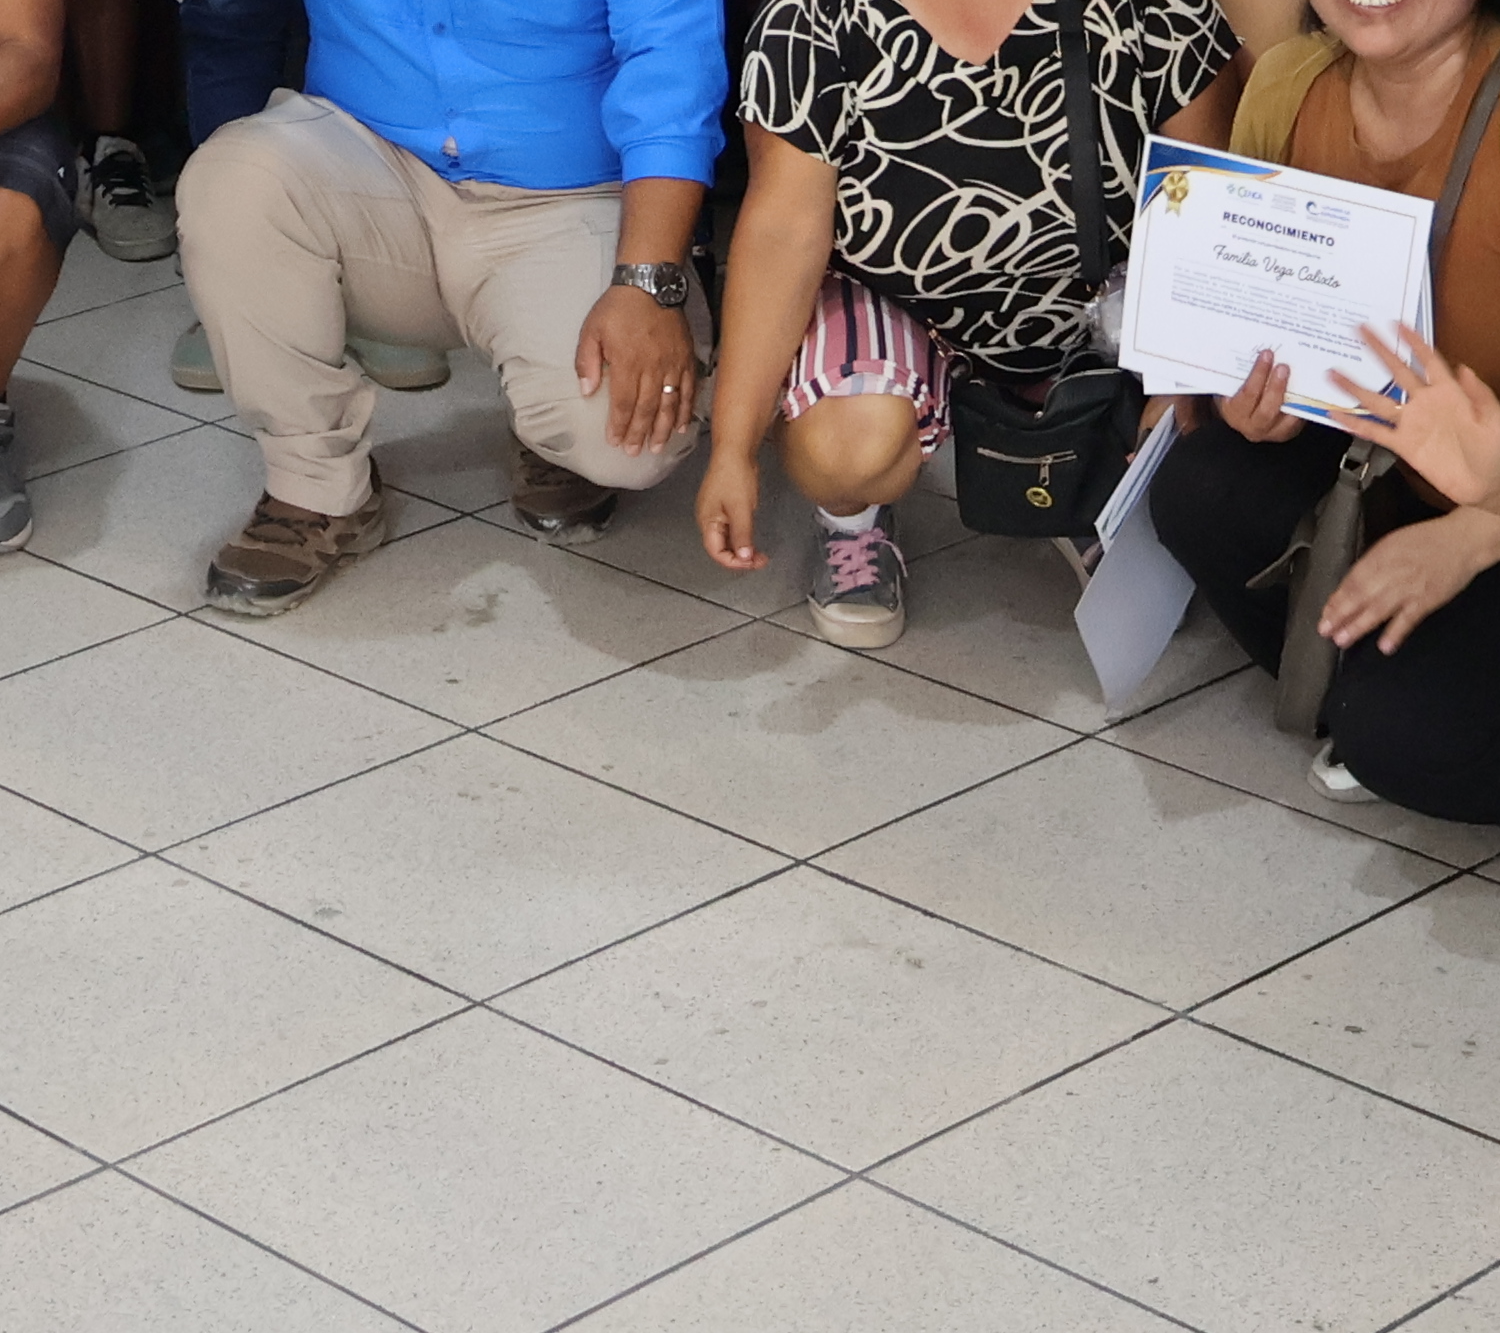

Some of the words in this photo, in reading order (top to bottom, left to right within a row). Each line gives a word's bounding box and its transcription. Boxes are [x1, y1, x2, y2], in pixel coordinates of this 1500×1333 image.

[1223, 211, 1335, 247] RECONOCIMIENTO
[1213, 244, 1258, 268] Familia
[1262, 256, 1294, 278] Vega
[1297, 265, 1341, 289] Calixto
